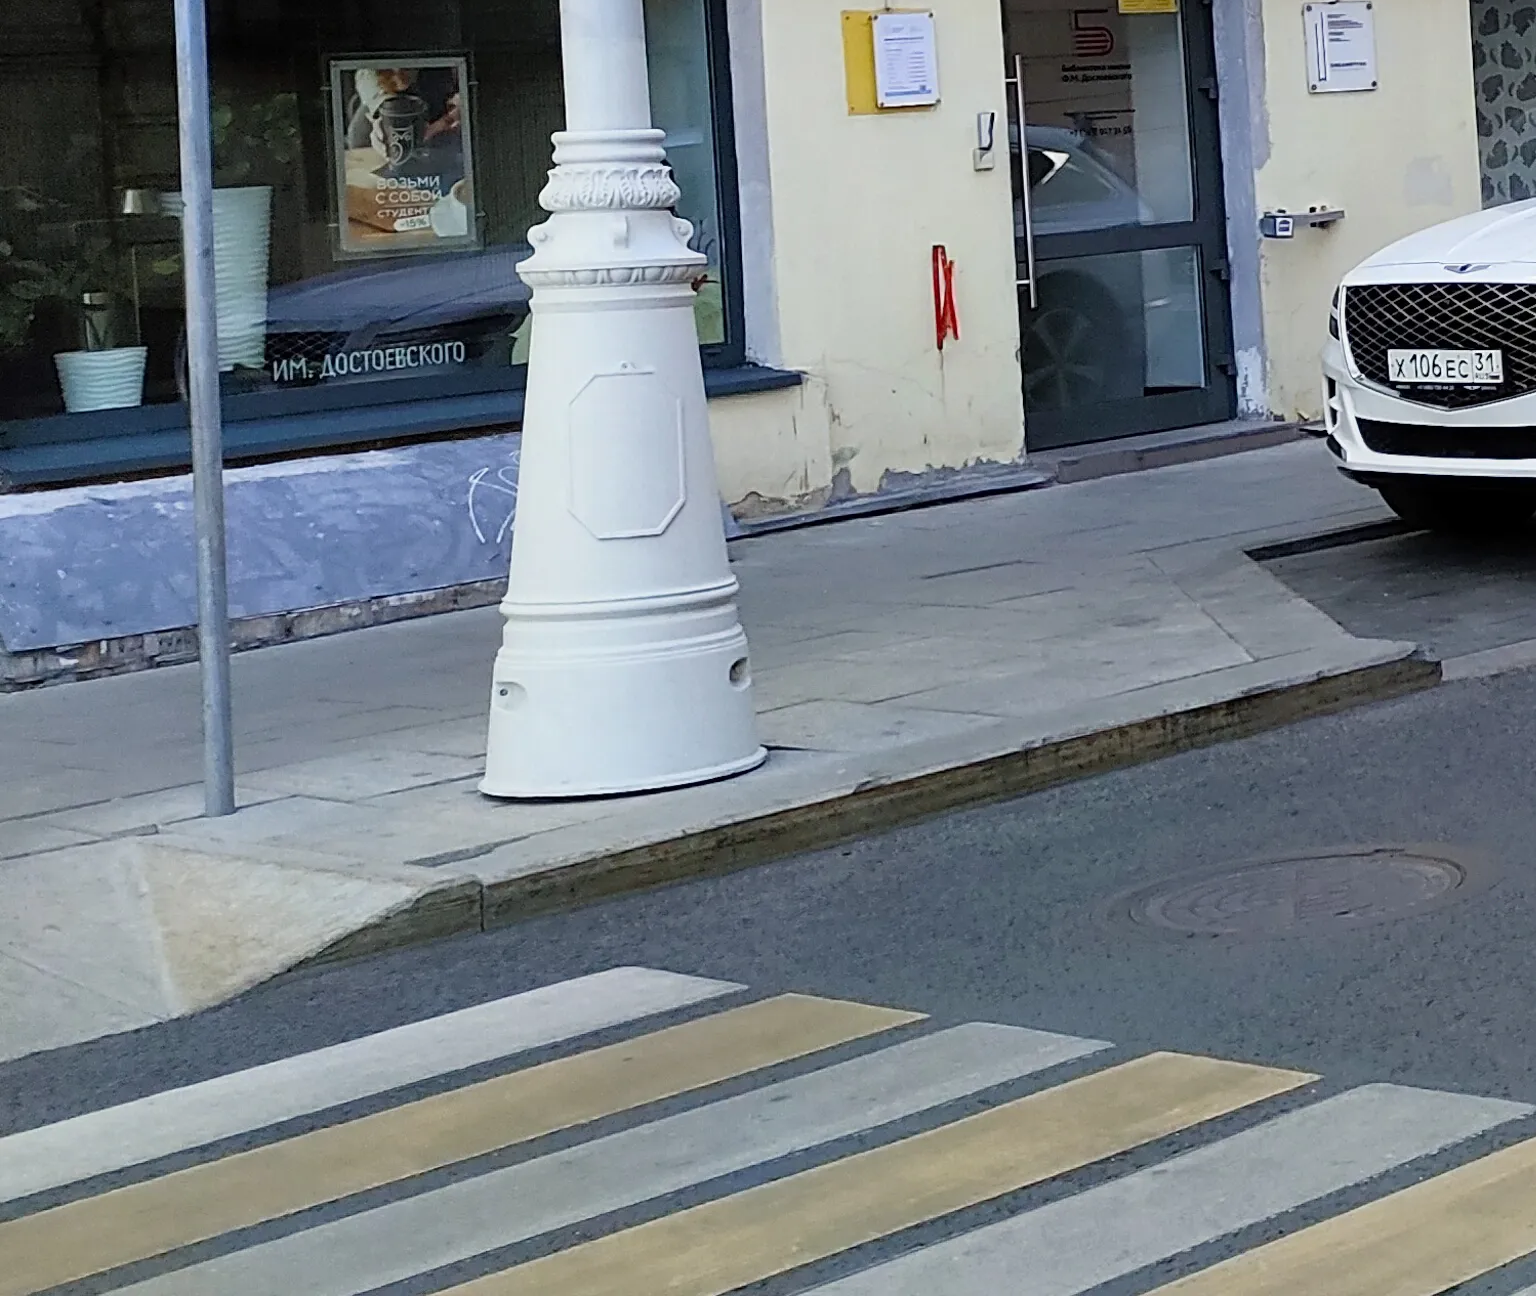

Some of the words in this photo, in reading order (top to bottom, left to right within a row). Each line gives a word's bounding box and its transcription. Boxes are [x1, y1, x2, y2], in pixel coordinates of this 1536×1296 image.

[376, 175, 440, 190] ВОЗЬМИ
[375, 191, 386, 204] С
[388, 188, 442, 203] СОБОЙ
[376, 206, 430, 218] СТУДЕНТ
[273, 357, 314, 382] ИМ.
[319, 341, 466, 380] ДОСТОЕВСКОГО
[1395, 353, 1469, 379] Х106ЕС
[1474, 352, 1495, 373] 31
